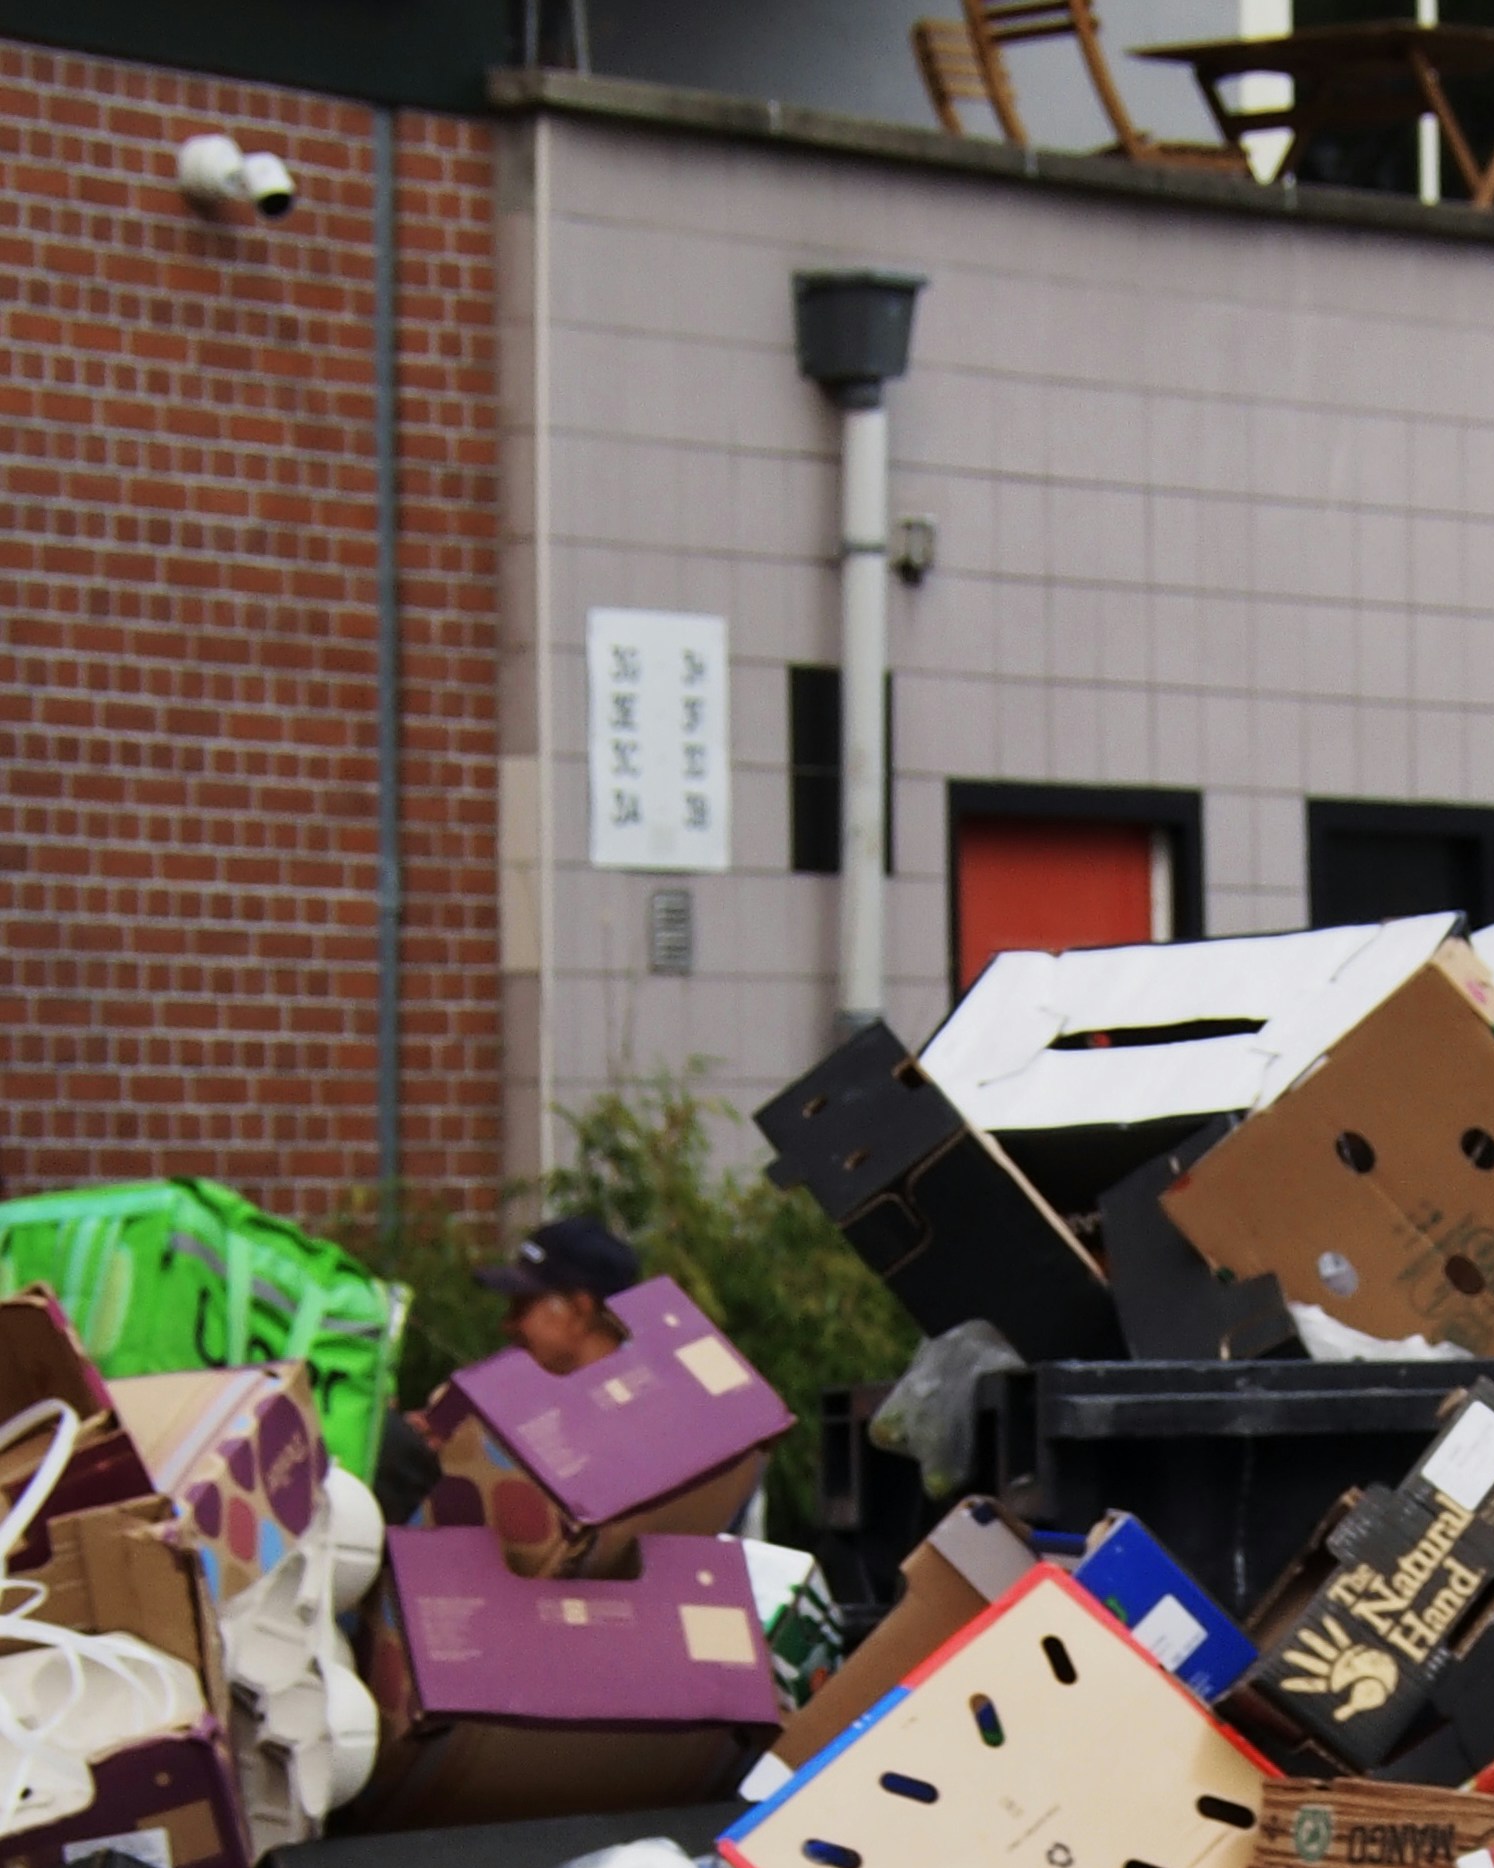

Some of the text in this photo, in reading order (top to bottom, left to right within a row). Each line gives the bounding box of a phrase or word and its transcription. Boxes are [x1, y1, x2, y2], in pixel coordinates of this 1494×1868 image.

[1326, 1563, 1377, 1607] The
[1351, 1492, 1475, 1635] Natural
[1387, 1555, 1482, 1664] Hand
[1347, 1822, 1455, 1866] MANGO
